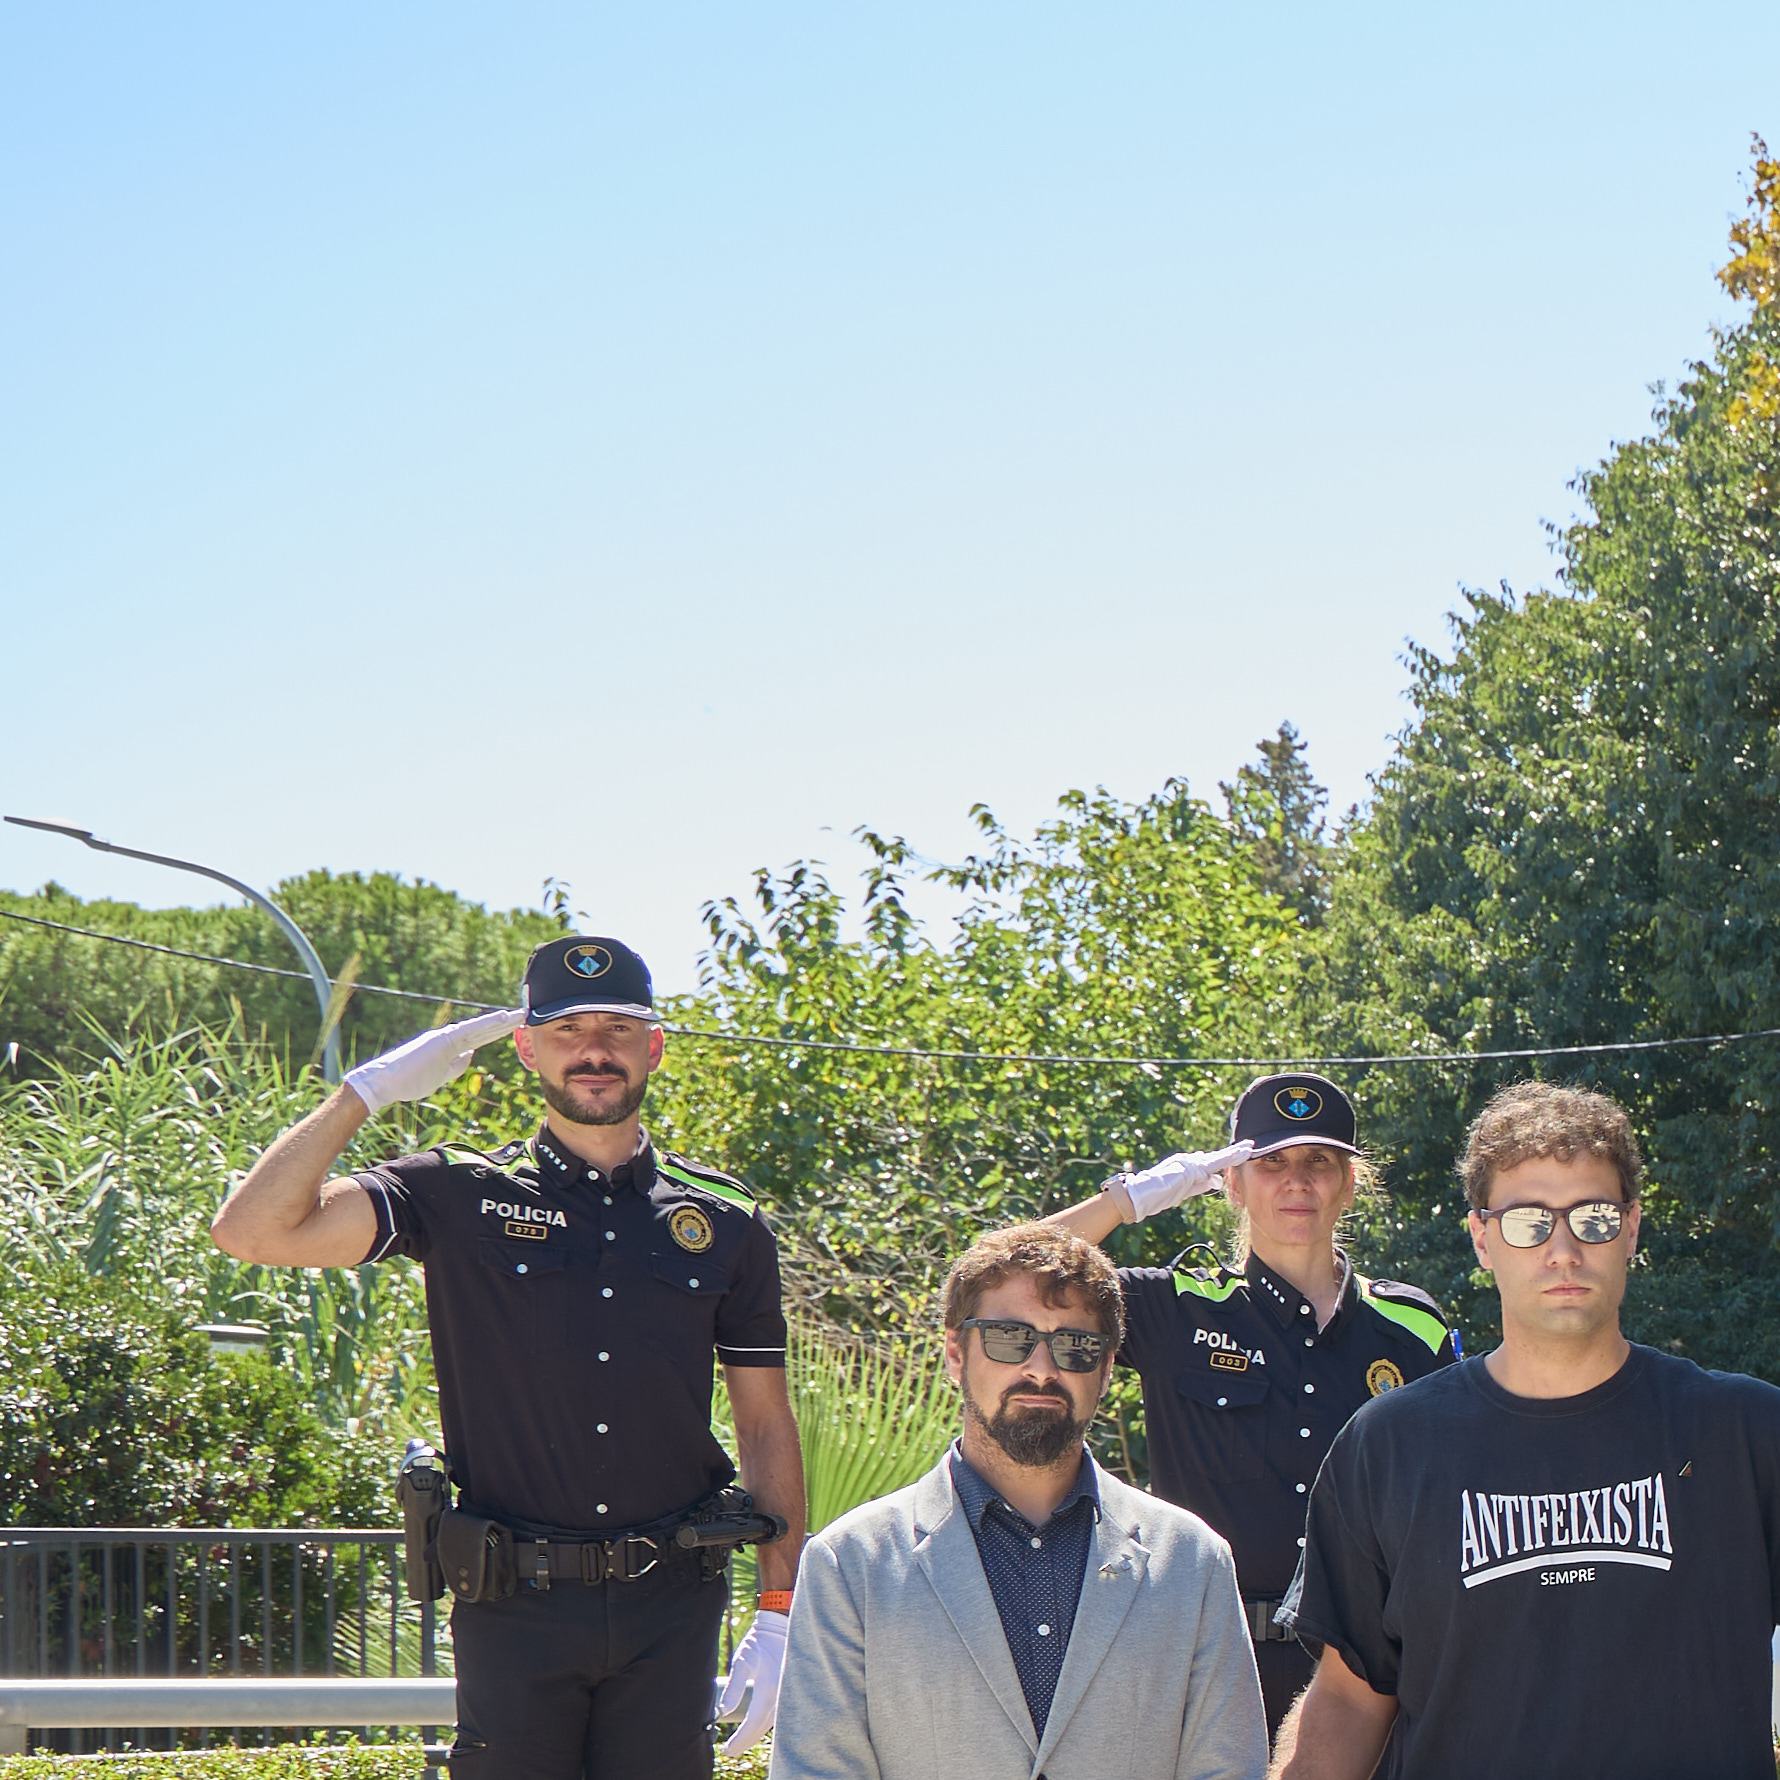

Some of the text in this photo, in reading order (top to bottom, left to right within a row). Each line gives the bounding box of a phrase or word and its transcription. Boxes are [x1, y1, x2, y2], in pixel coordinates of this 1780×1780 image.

[481, 1198, 567, 1228] POLICIA
[1193, 1328, 1266, 1365] POLIIA
[1461, 1472, 1673, 1573] ANTIFEIXISTA
[1540, 1567, 1596, 1586] SEMPRE
